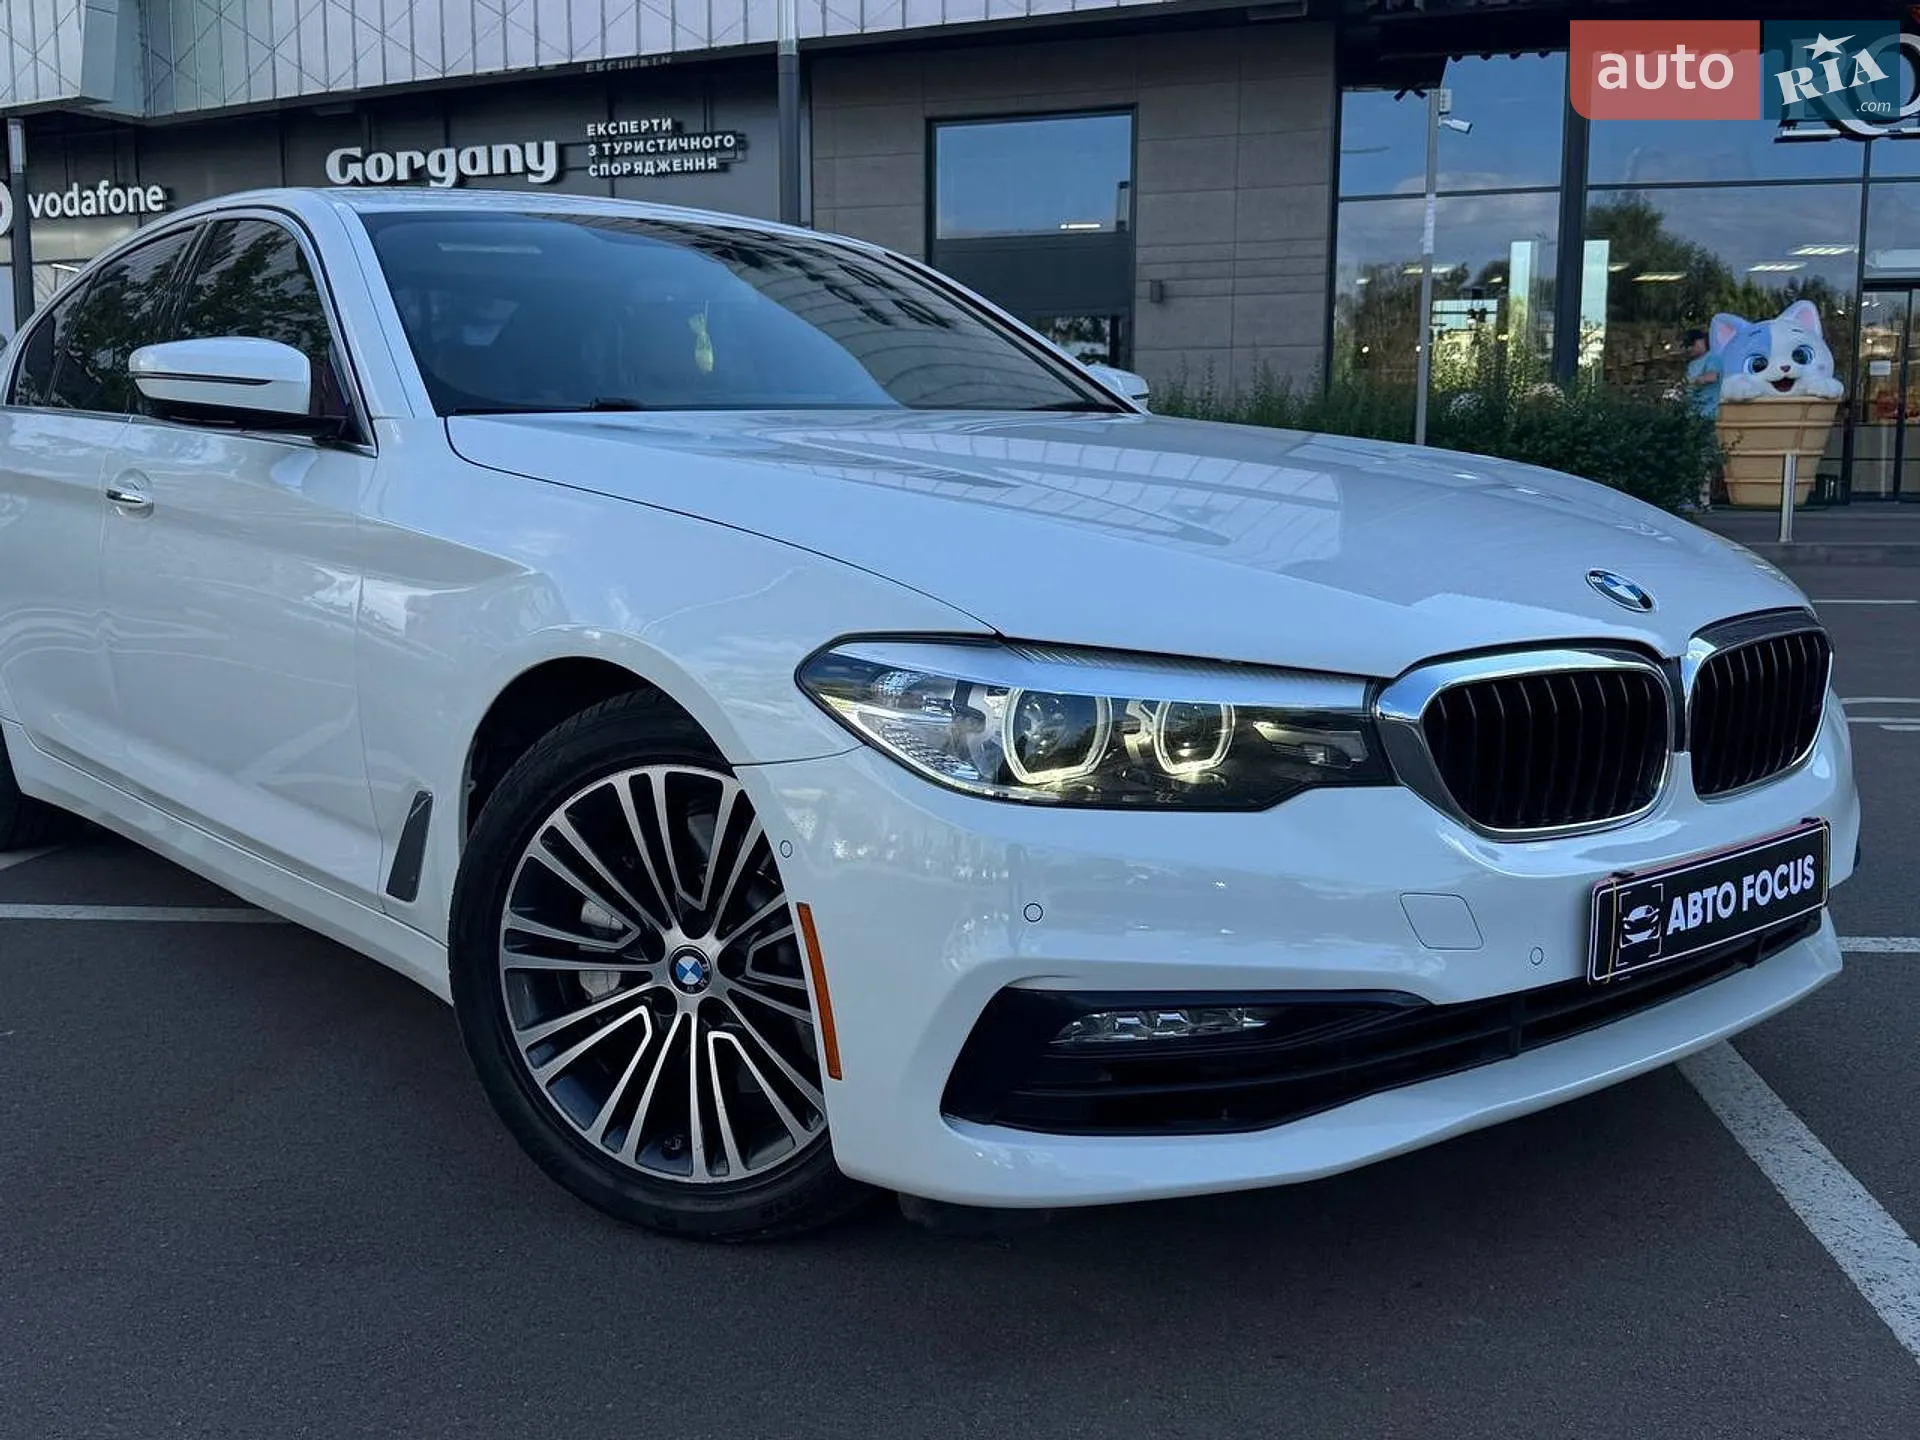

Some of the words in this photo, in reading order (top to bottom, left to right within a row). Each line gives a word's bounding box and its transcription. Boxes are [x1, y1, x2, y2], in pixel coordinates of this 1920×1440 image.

[586, 118, 673, 137] ЕКСПЕРТИ
[602, 135, 735, 156] ТУРИСТИЧНОГО
[325, 140, 557, 187] Gorgany
[588, 157, 718, 177] СПОРЯДЖЕННЯ
[27, 180, 164, 219] vodafone
[1666, 881, 1737, 936] АВТО
[1741, 854, 1815, 912] FOCUS
